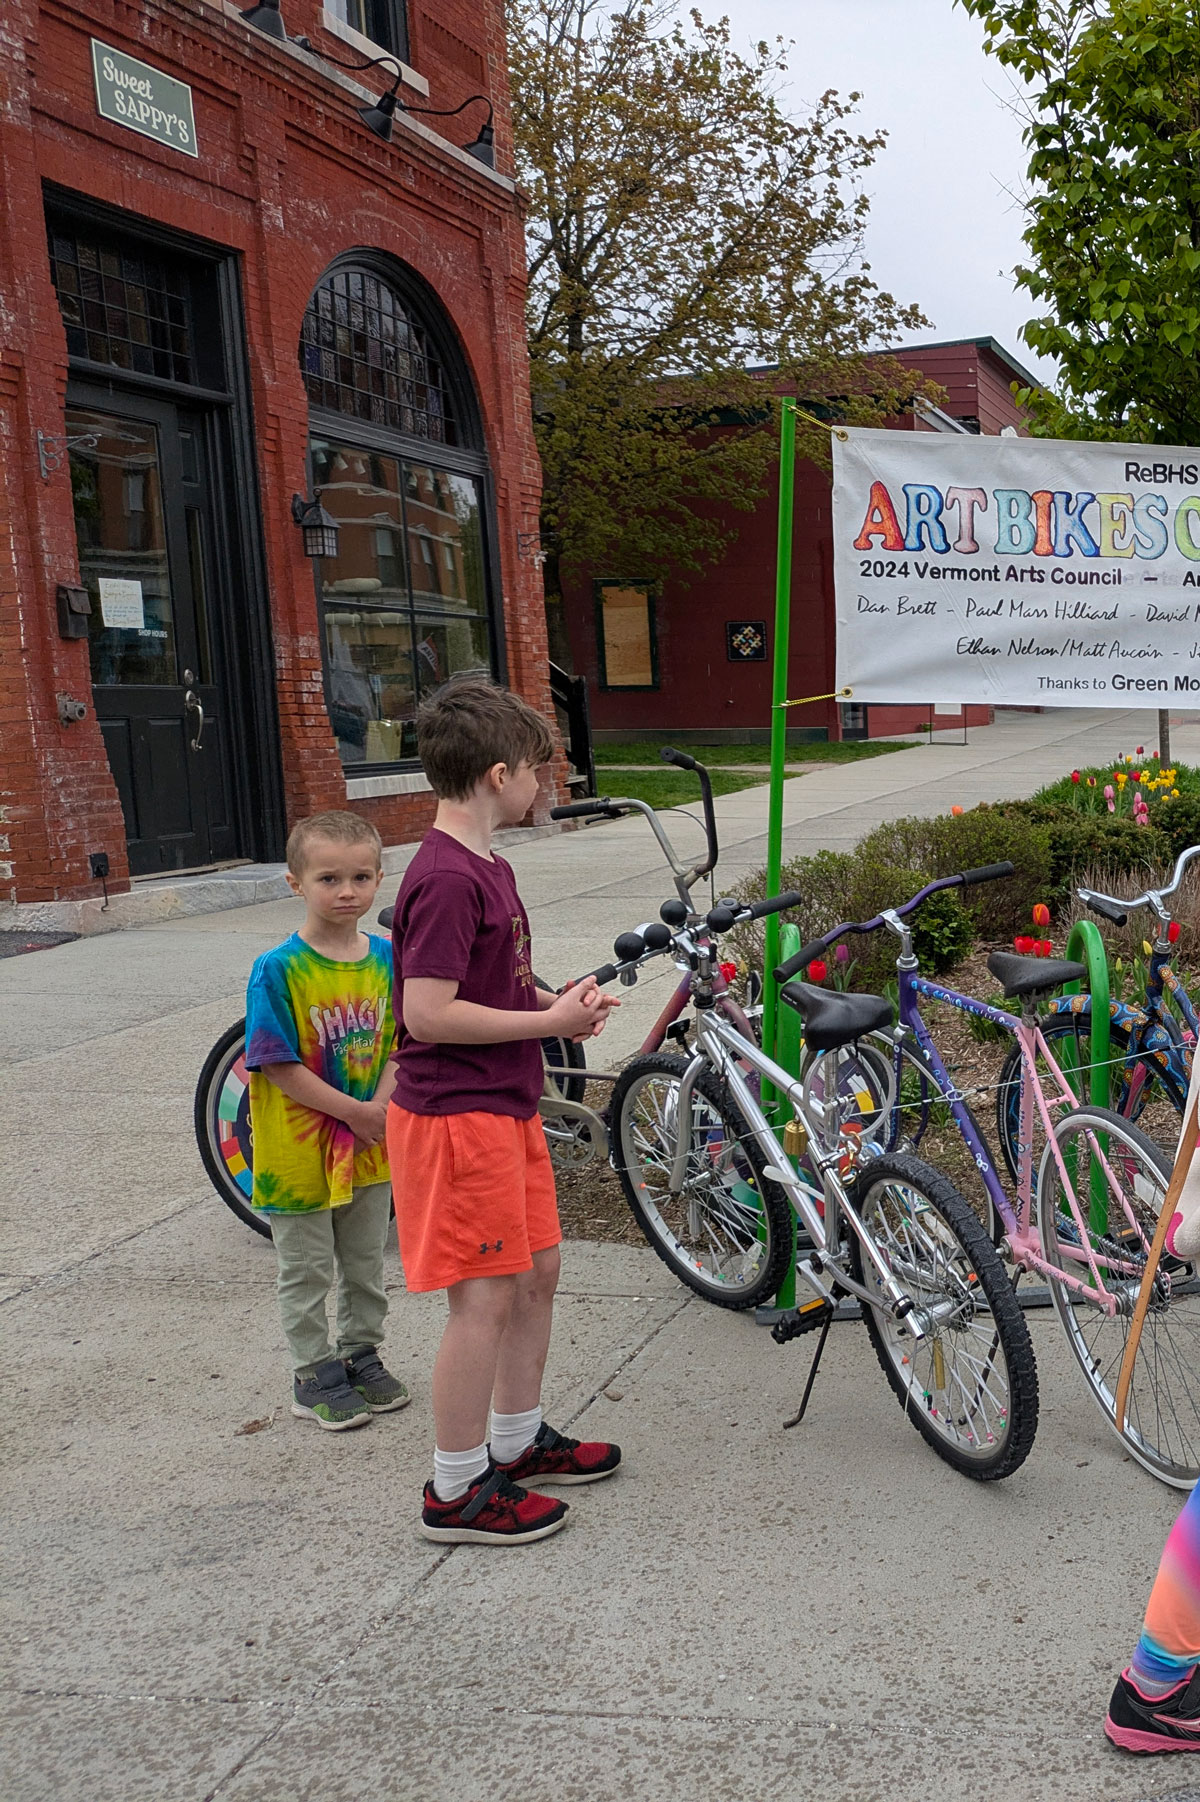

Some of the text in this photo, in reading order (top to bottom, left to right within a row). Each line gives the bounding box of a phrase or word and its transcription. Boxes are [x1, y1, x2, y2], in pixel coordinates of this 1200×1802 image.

[103, 57, 154, 100] Sweet
[114, 90, 190, 143] SAPPY'S
[1126, 462, 1198, 484] ReBHS
[853, 480, 988, 554] ART
[993, 488, 1168, 560] BIKES
[860, 560, 910, 578] 2024
[914, 562, 1000, 581] Vermont
[1005, 565, 1045, 583] Arts
[1051, 567, 1121, 585] Council
[858, 595, 889, 613] Dan
[897, 596, 937, 615] Brett
[966, 598, 1003, 617] Paul
[1055, 601, 1118, 620] Hilliard
[1146, 604, 1190, 622] David
[138, 629, 151, 637] SHOP
[957, 637, 1001, 655] Ethan
[1108, 640, 1163, 659] Aucoin
[1038, 677, 1088, 689] Thanks
[1093, 678, 1106, 689] to
[1112, 674, 1168, 691] Green
